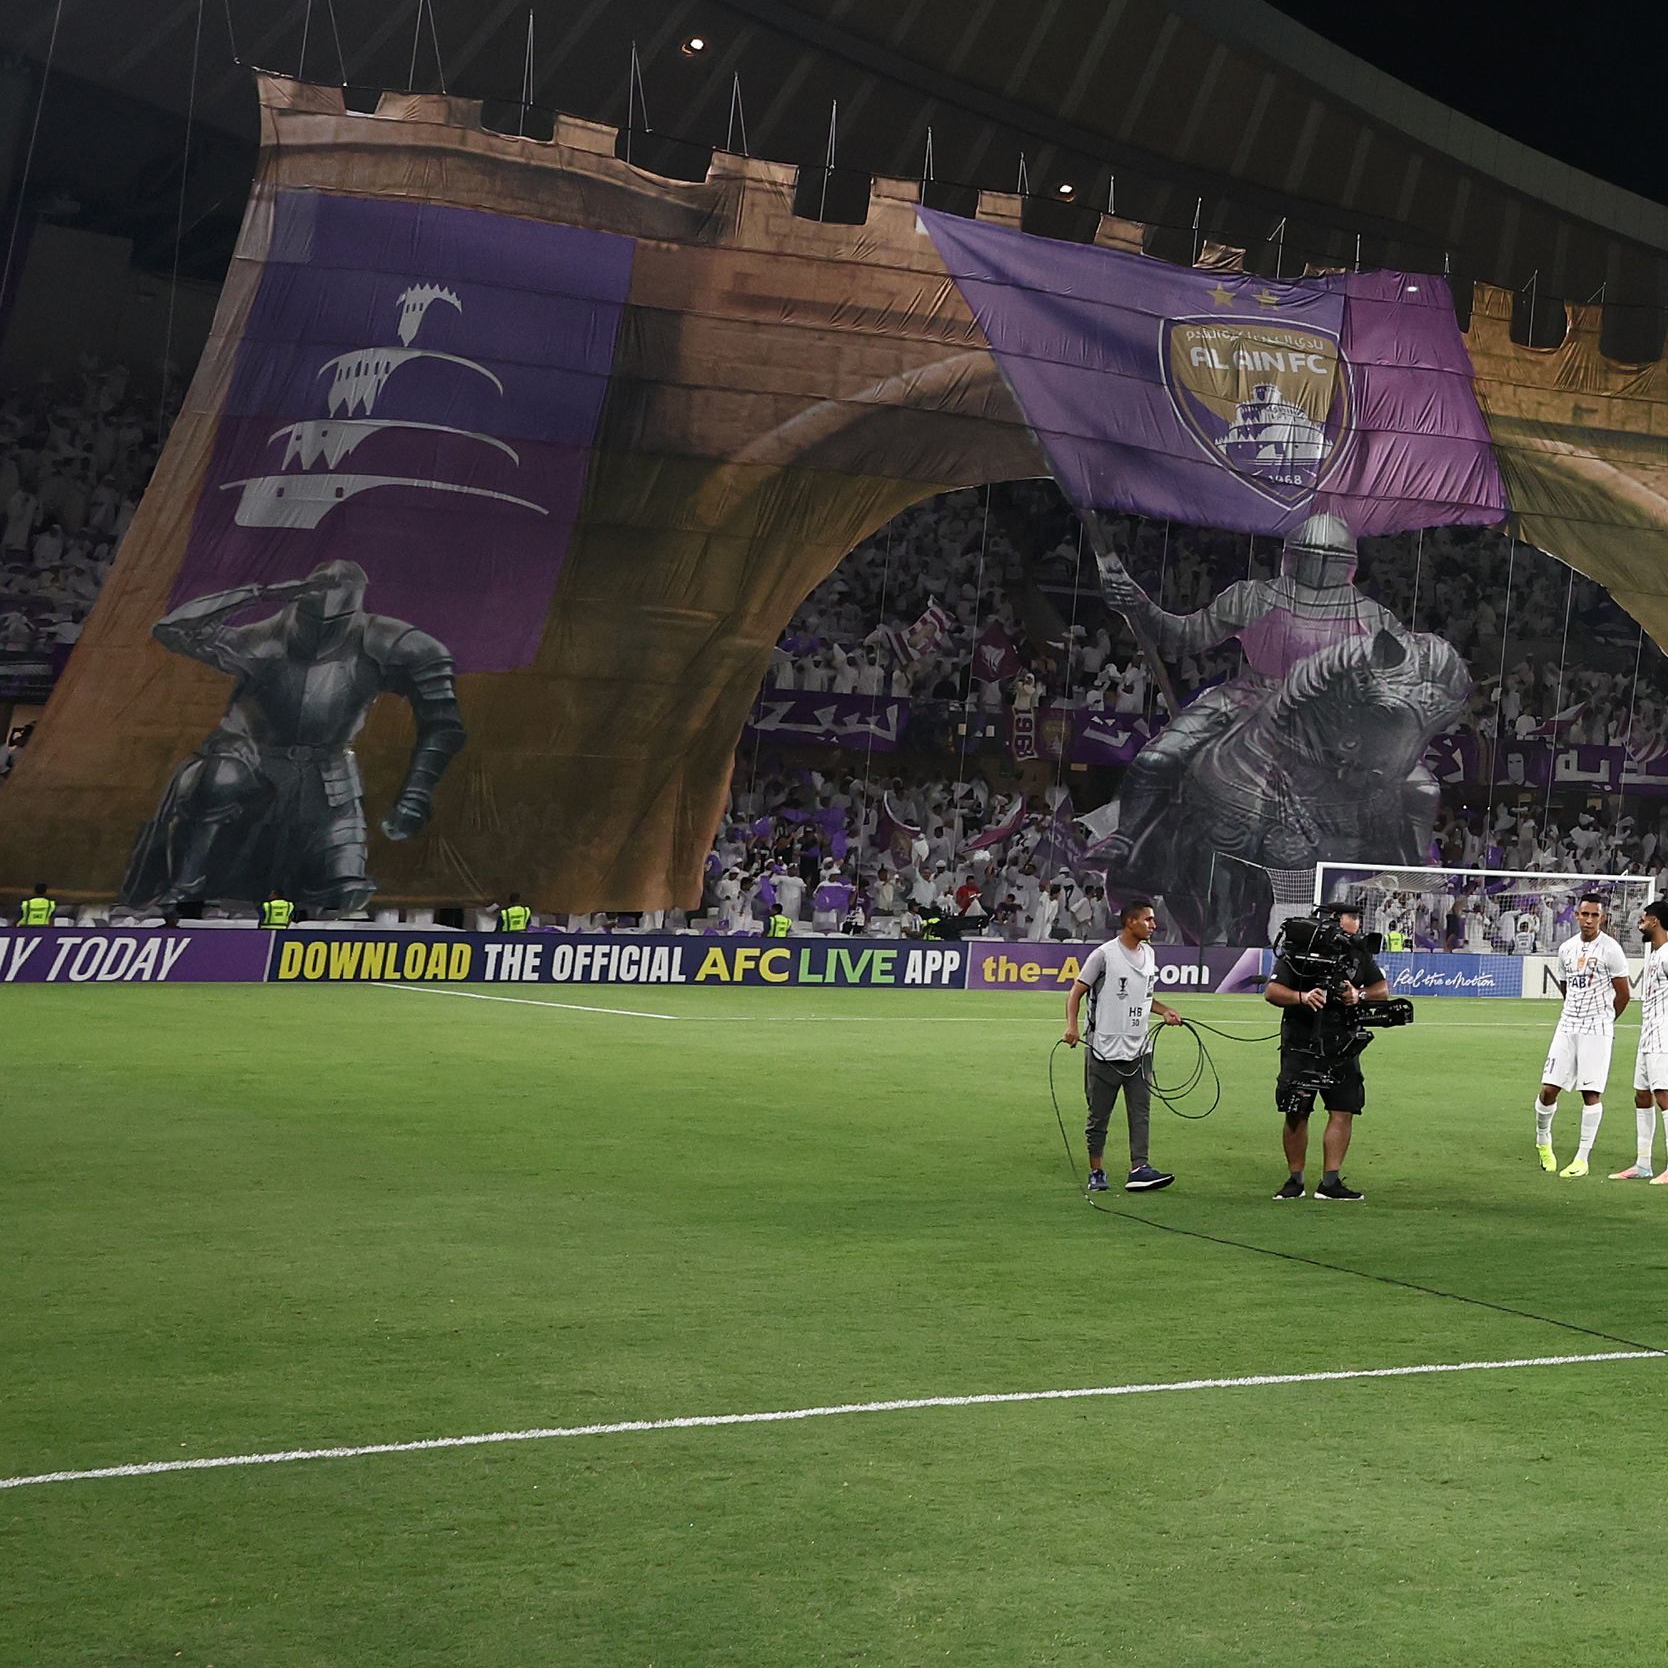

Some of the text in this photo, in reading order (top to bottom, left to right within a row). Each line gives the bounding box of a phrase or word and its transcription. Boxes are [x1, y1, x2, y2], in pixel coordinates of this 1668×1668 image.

[1191, 347, 1328, 374] AL AIN FC
[46, 936, 192, 982] TODAY
[278, 940, 961, 984] DOWNLOAD THE OFFICIAL AFC LIVE APP
[1422, 973, 1445, 987] the
